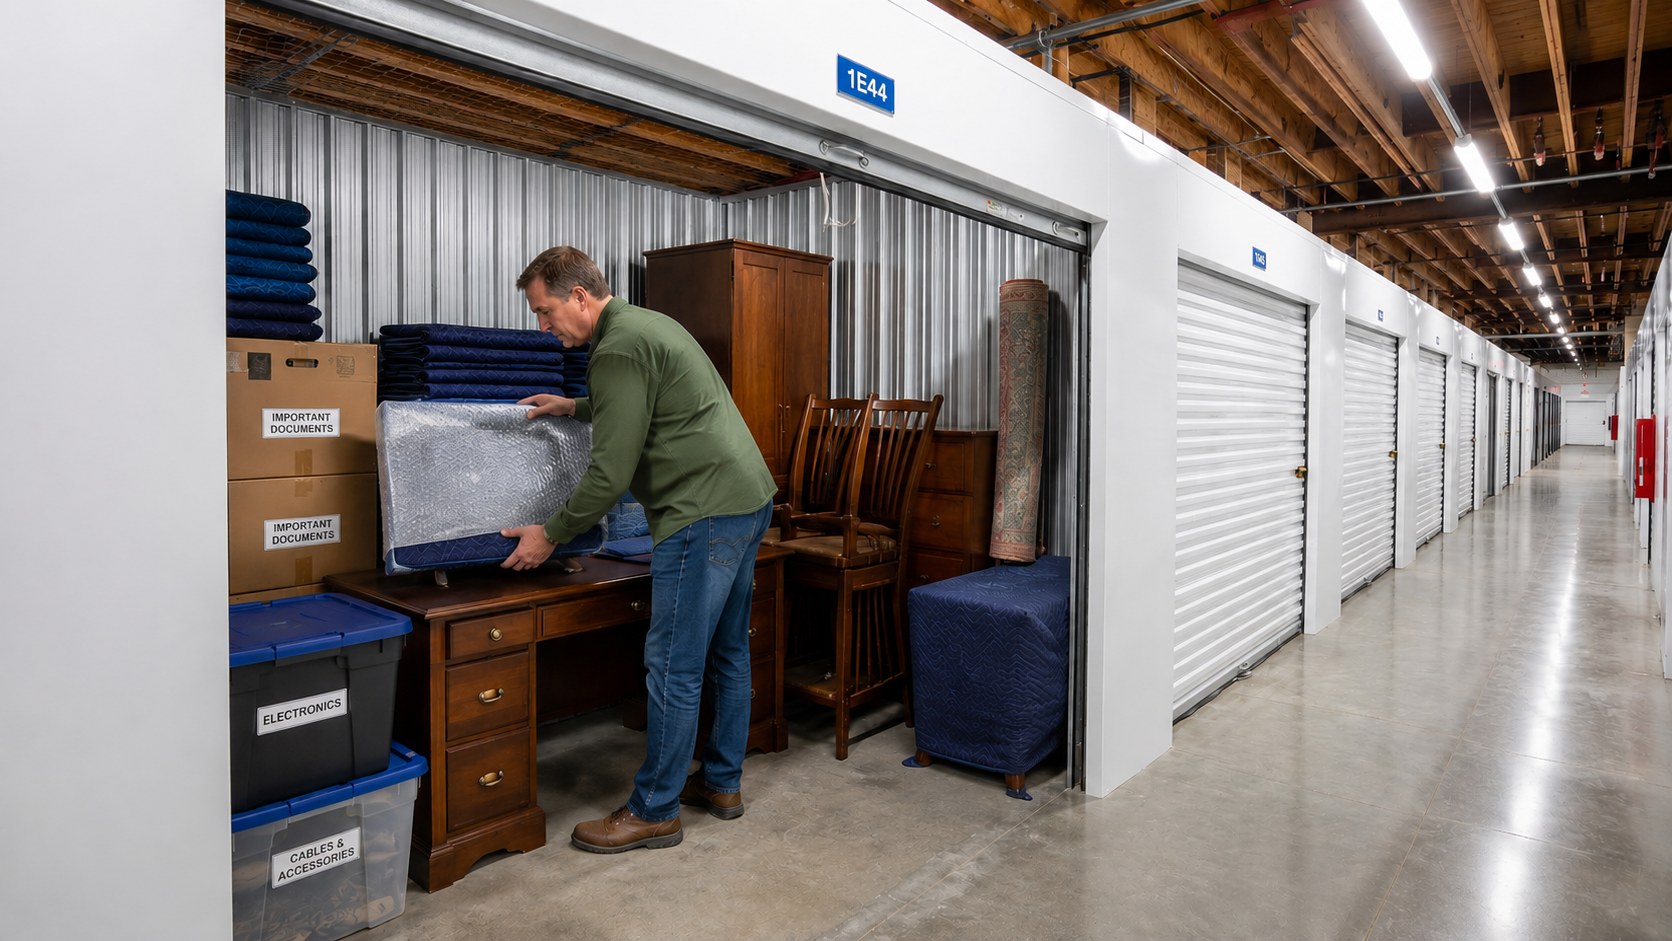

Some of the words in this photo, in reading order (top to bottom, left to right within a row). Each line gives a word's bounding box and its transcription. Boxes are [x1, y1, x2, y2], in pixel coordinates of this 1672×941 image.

[848, 69, 888, 102] 1E44
[272, 413, 331, 422] IMPORTANT
[270, 424, 333, 433] DOCUMENTS
[273, 519, 332, 532] IMPORTANT
[272, 530, 335, 544] DOCUMENTS
[263, 698, 341, 725] ELECTRONICS
[290, 841, 334, 864] CABLES
[336, 838, 344, 849] &
[278, 847, 355, 882] ACCESSORIES
